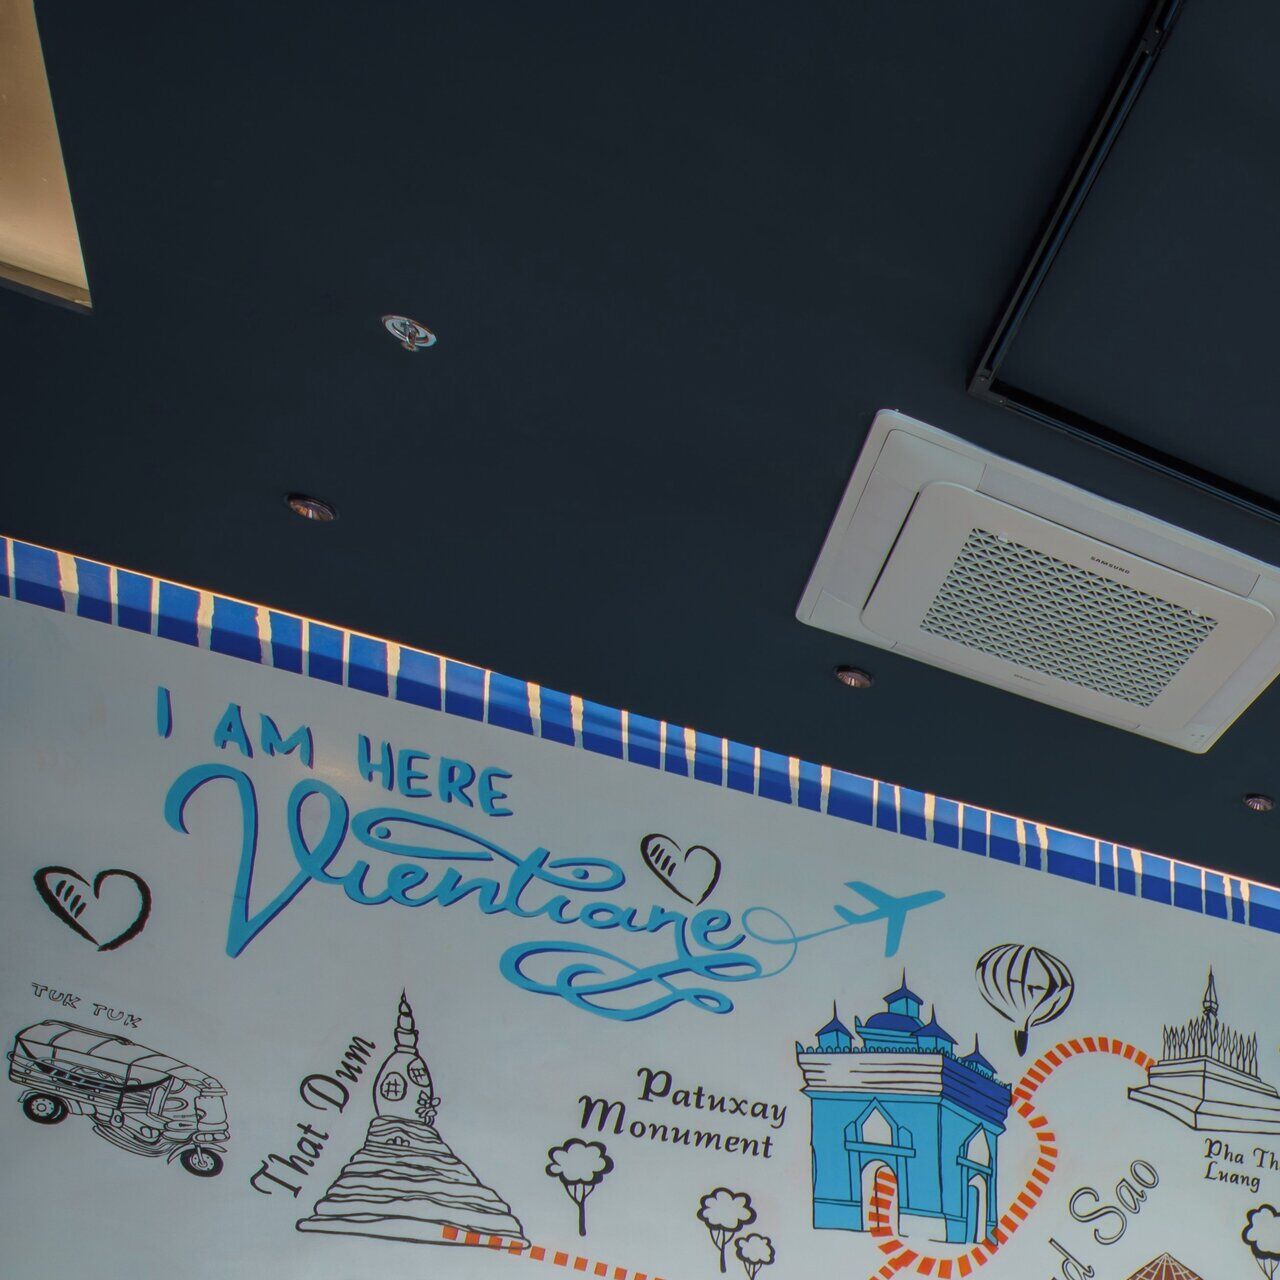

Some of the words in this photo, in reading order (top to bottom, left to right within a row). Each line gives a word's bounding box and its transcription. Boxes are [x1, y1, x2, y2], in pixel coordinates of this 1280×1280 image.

[1090, 556, 1131, 575] SAMSUNG
[156, 685, 173, 739] I
[212, 703, 315, 769] AM
[357, 733, 514, 818] HERE
[163, 763, 763, 1022] Vientiane
[32, 982, 81, 1009] TUK
[93, 1003, 142, 1028] TUK
[250, 1121, 328, 1199] That
[300, 1036, 376, 1113] Dum
[578, 1095, 774, 1158] Monument
[637, 1067, 788, 1128] Patuxay
[1205, 1138, 1244, 1164] Pha
[1205, 1161, 1260, 1193] Luang
[1069, 1159, 1159, 1244] Sao
